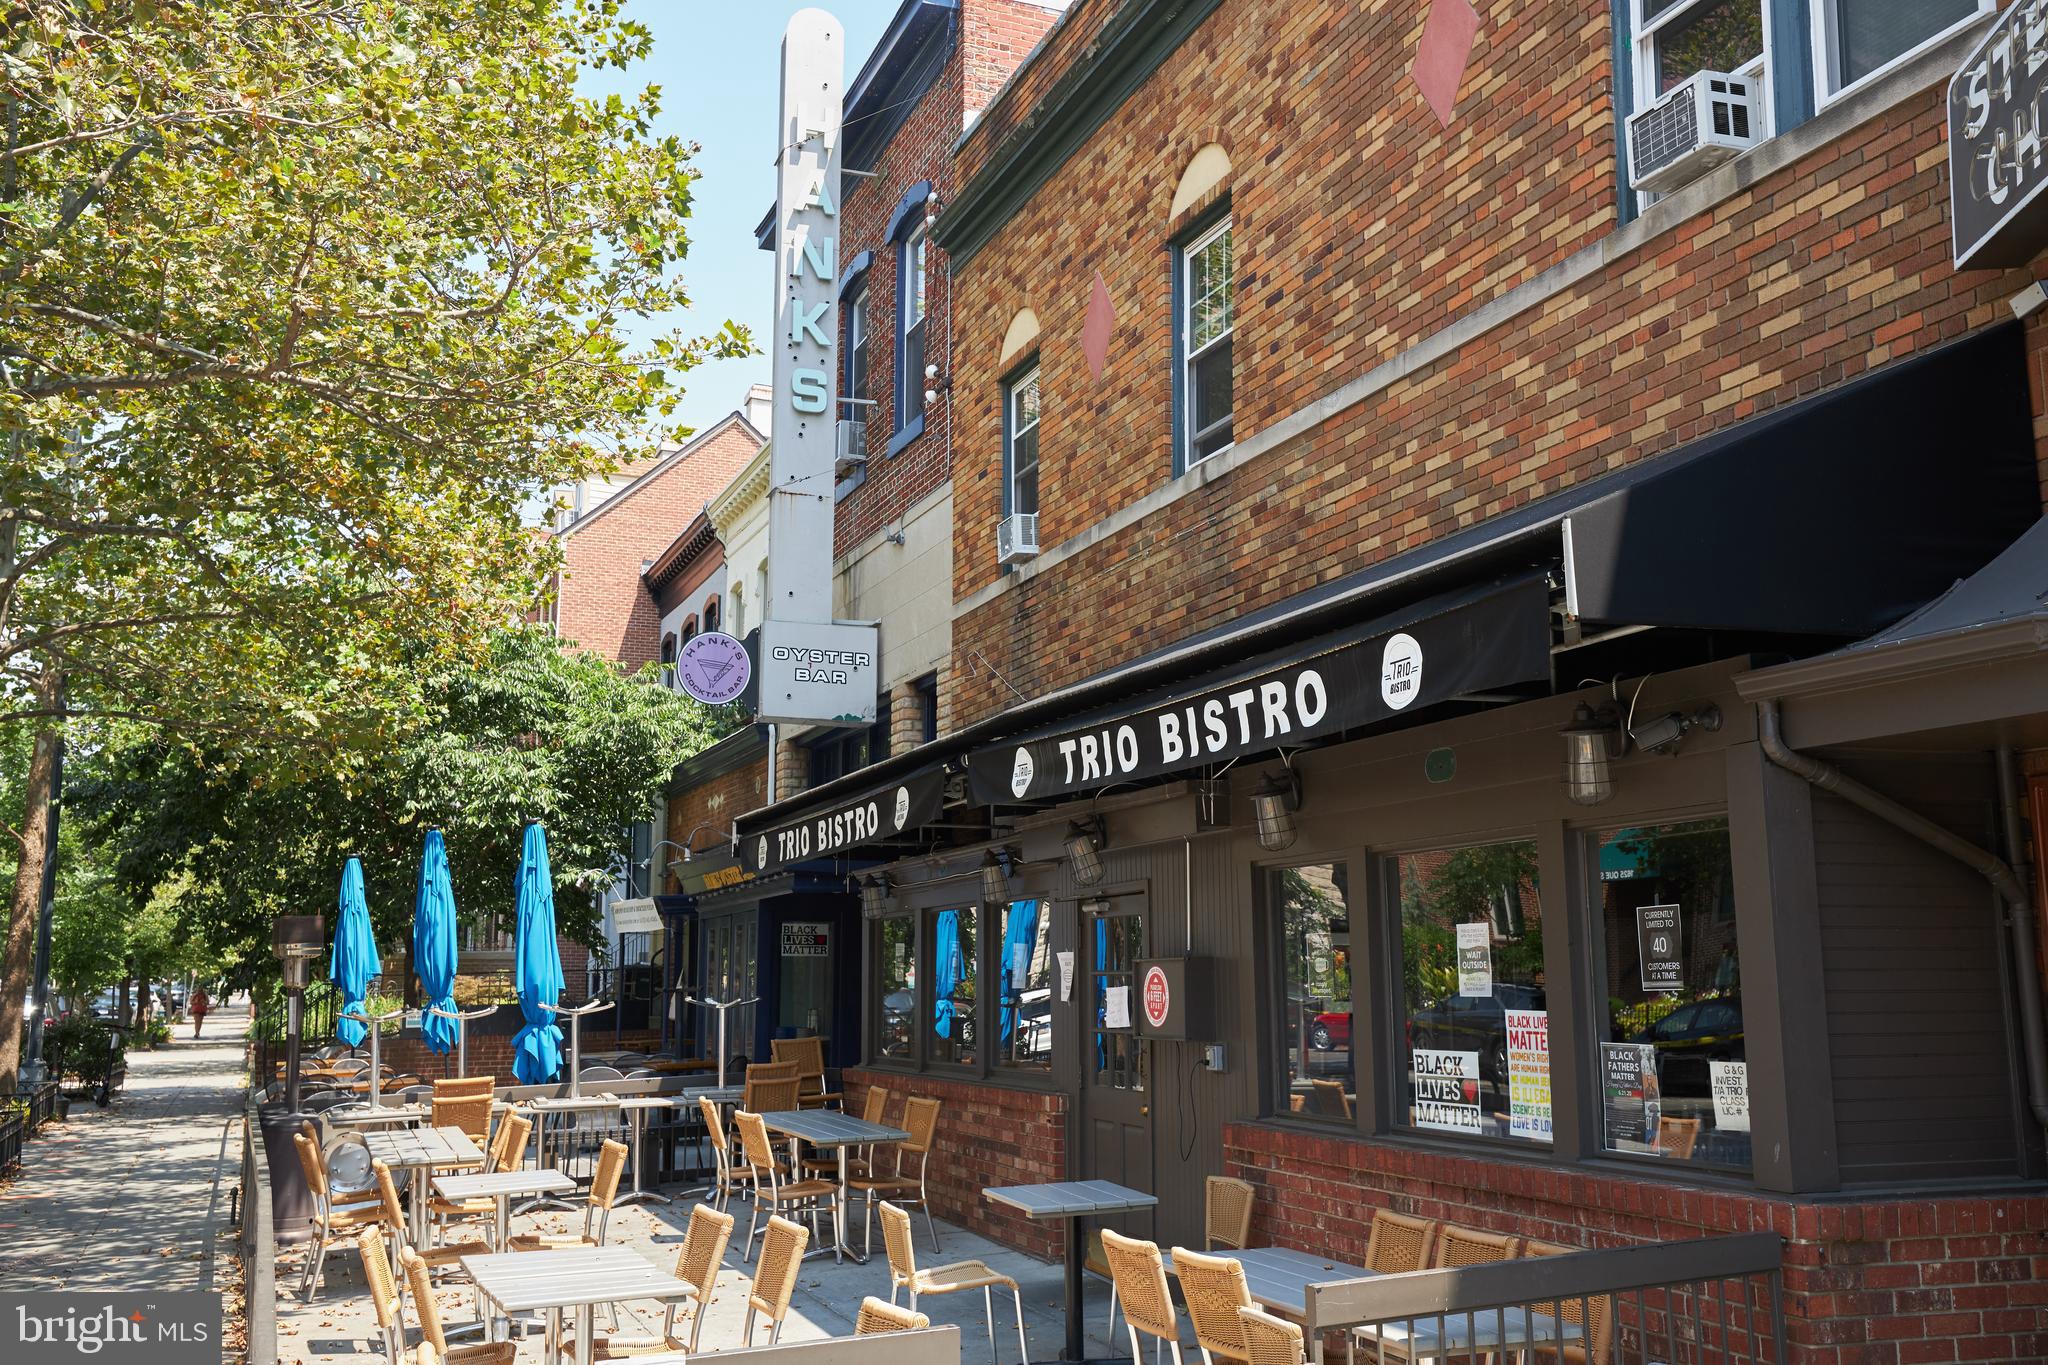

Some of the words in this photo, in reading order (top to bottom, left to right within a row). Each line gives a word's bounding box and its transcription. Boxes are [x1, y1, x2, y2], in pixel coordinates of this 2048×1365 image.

[792, 103, 836, 414] HANKS
[686, 637, 743, 660] HANK'S
[772, 646, 870, 666] OYSTER
[1390, 656, 1411, 680] TRIO
[794, 668, 847, 684] BAR
[685, 672, 728, 698] COCKTAIL
[728, 676, 744, 694] BAR
[1390, 679, 1411, 694] BISTRO
[1059, 725, 1140, 785] TRIO
[1158, 669, 1328, 765] BISTRO
[778, 826, 810, 862] TRIO
[818, 802, 878, 852] BISTRO
[1644, 910, 1674, 920] CURRENTLY
[783, 926, 818, 934] BLACK
[1646, 920, 1664, 928] LIMITED
[1665, 920, 1674, 928] TO
[784, 935, 815, 944] LIVES
[1653, 937, 1666, 952] 40
[783, 946, 828, 954] MATTER
[1462, 960, 1487, 969] OUTSIDE
[1648, 962, 1680, 970] CUSTOMERS
[1662, 972, 1676, 980] TIME
[1508, 1016, 1531, 1028] BLACK
[1510, 1052, 1535, 1062] WOMEN'S
[1610, 1051, 1634, 1060] BLACK
[1415, 1054, 1464, 1076] BLACK
[1608, 1062, 1639, 1072] FATHERS
[1520, 1076, 1538, 1085] HUMAN
[1611, 1072, 1635, 1080] MATTER
[1418, 1078, 1460, 1100] LIVES
[1512, 1087, 1520, 1101] IS
[1726, 1087, 1742, 1095] TRIO
[1720, 1096, 1745, 1106] CLASS
[1418, 1103, 1480, 1127] MATTER
[1512, 1104, 1535, 1116] SCIENCE
[1536, 1106, 1541, 1116] IS
[1512, 1116, 1529, 1130] LOVE
[1532, 1118, 1538, 1131] IS
